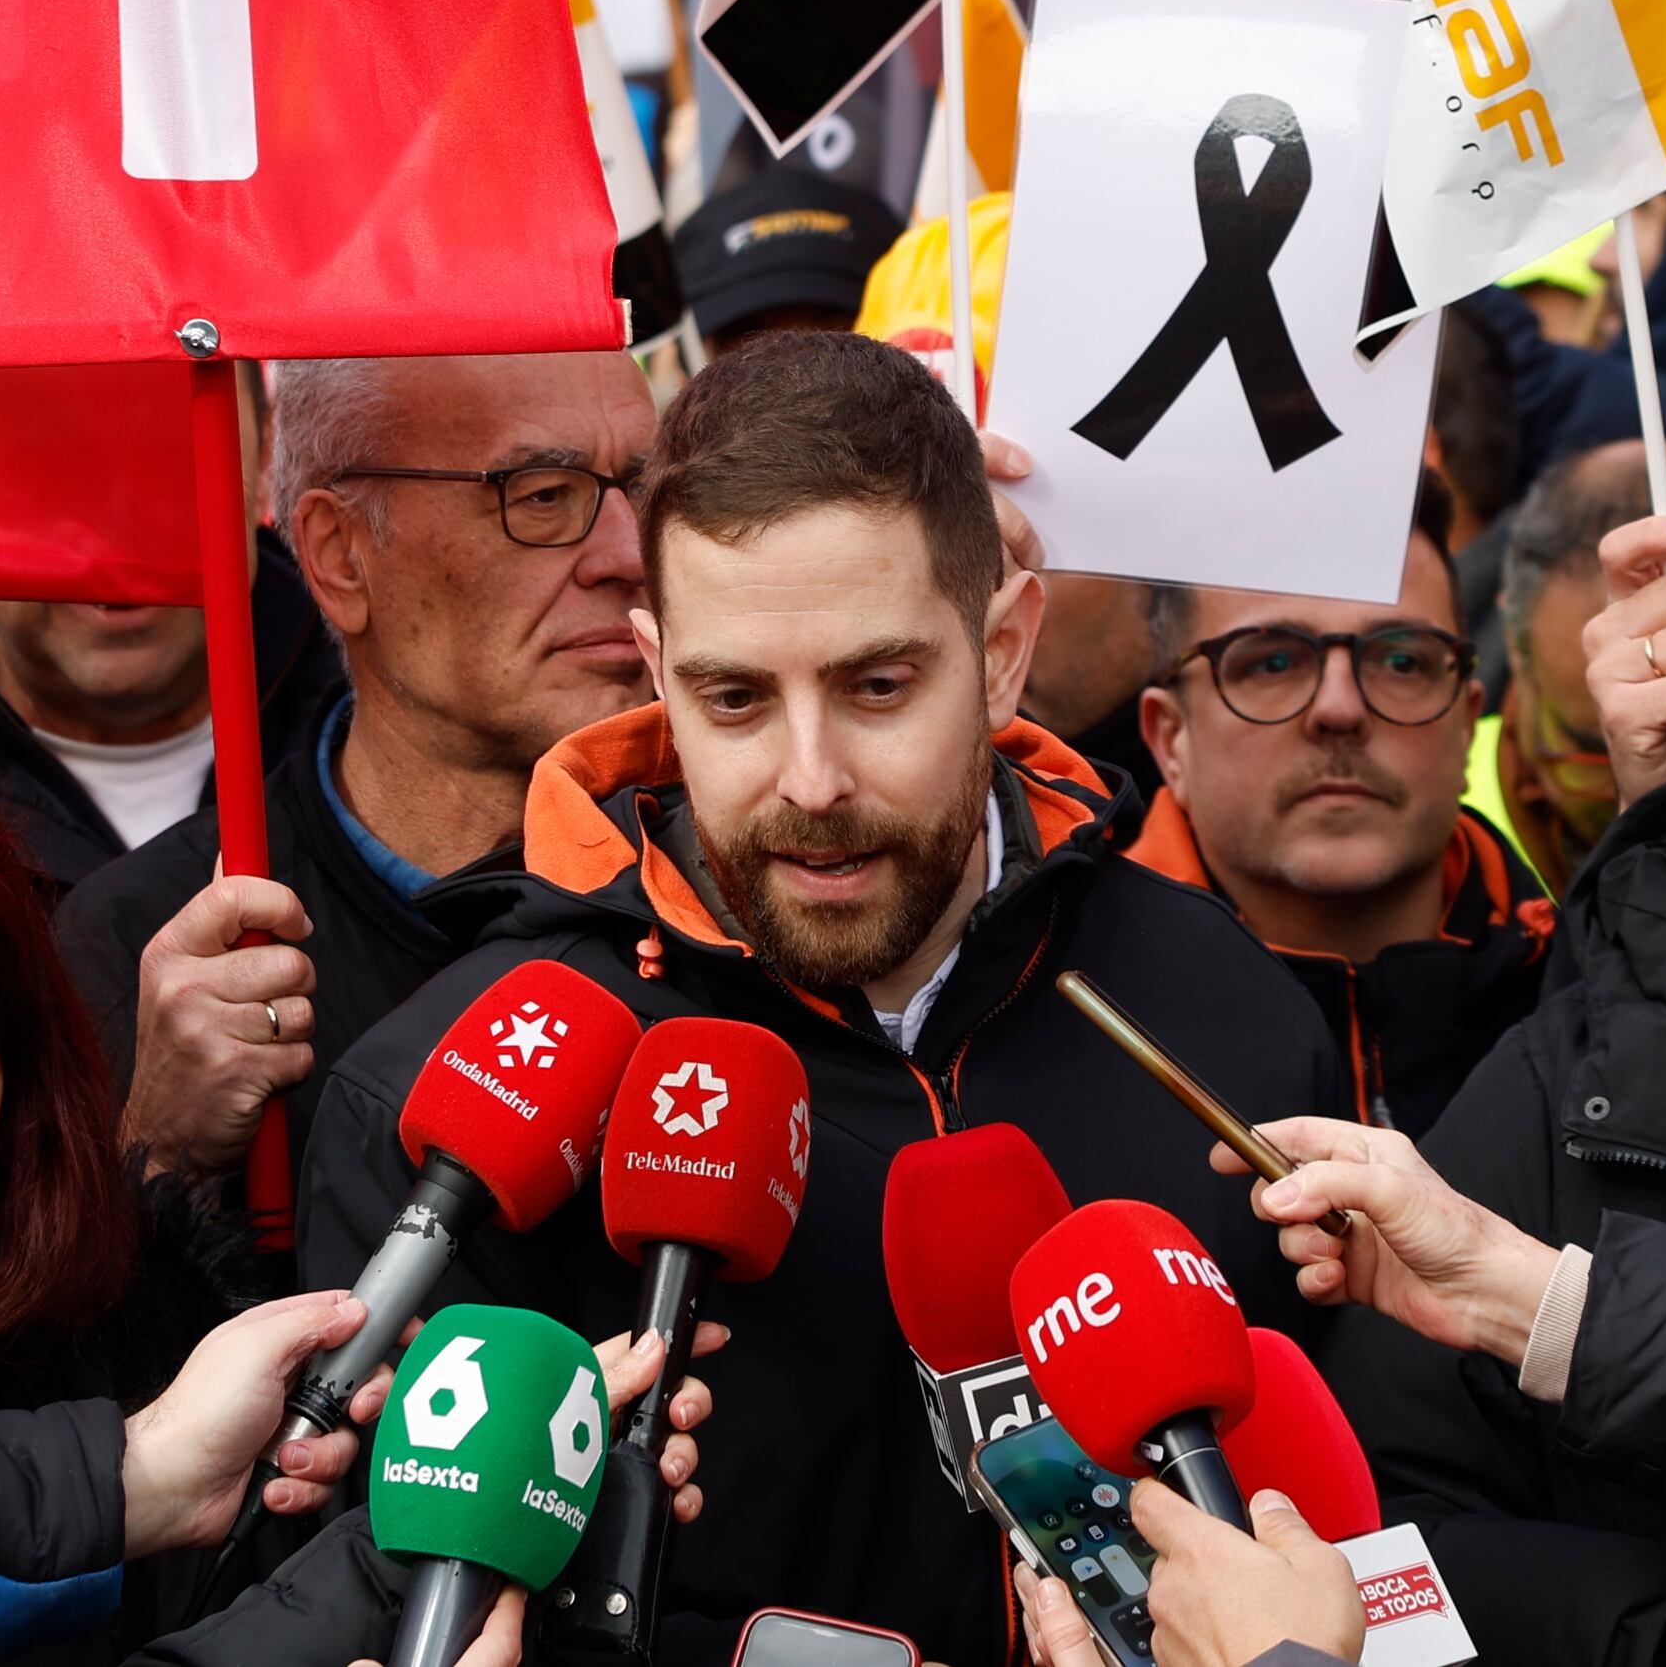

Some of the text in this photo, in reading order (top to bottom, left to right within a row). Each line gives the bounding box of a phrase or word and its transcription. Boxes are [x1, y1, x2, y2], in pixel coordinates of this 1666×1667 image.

[442, 1049, 539, 1121] OndaMadrid
[624, 1151, 735, 1180] TeleMadrid
[1152, 1247, 1237, 1306] rne
[1027, 1272, 1121, 1364] rne
[403, 1335, 489, 1450] 6
[548, 1365, 603, 1489] 6
[383, 1456, 480, 1493] laSexta
[521, 1479, 587, 1533] laSexta
[1363, 1576, 1411, 1602] BOCA
[1367, 1606, 1387, 1621] DE
[1383, 1587, 1439, 1616] TODOS
